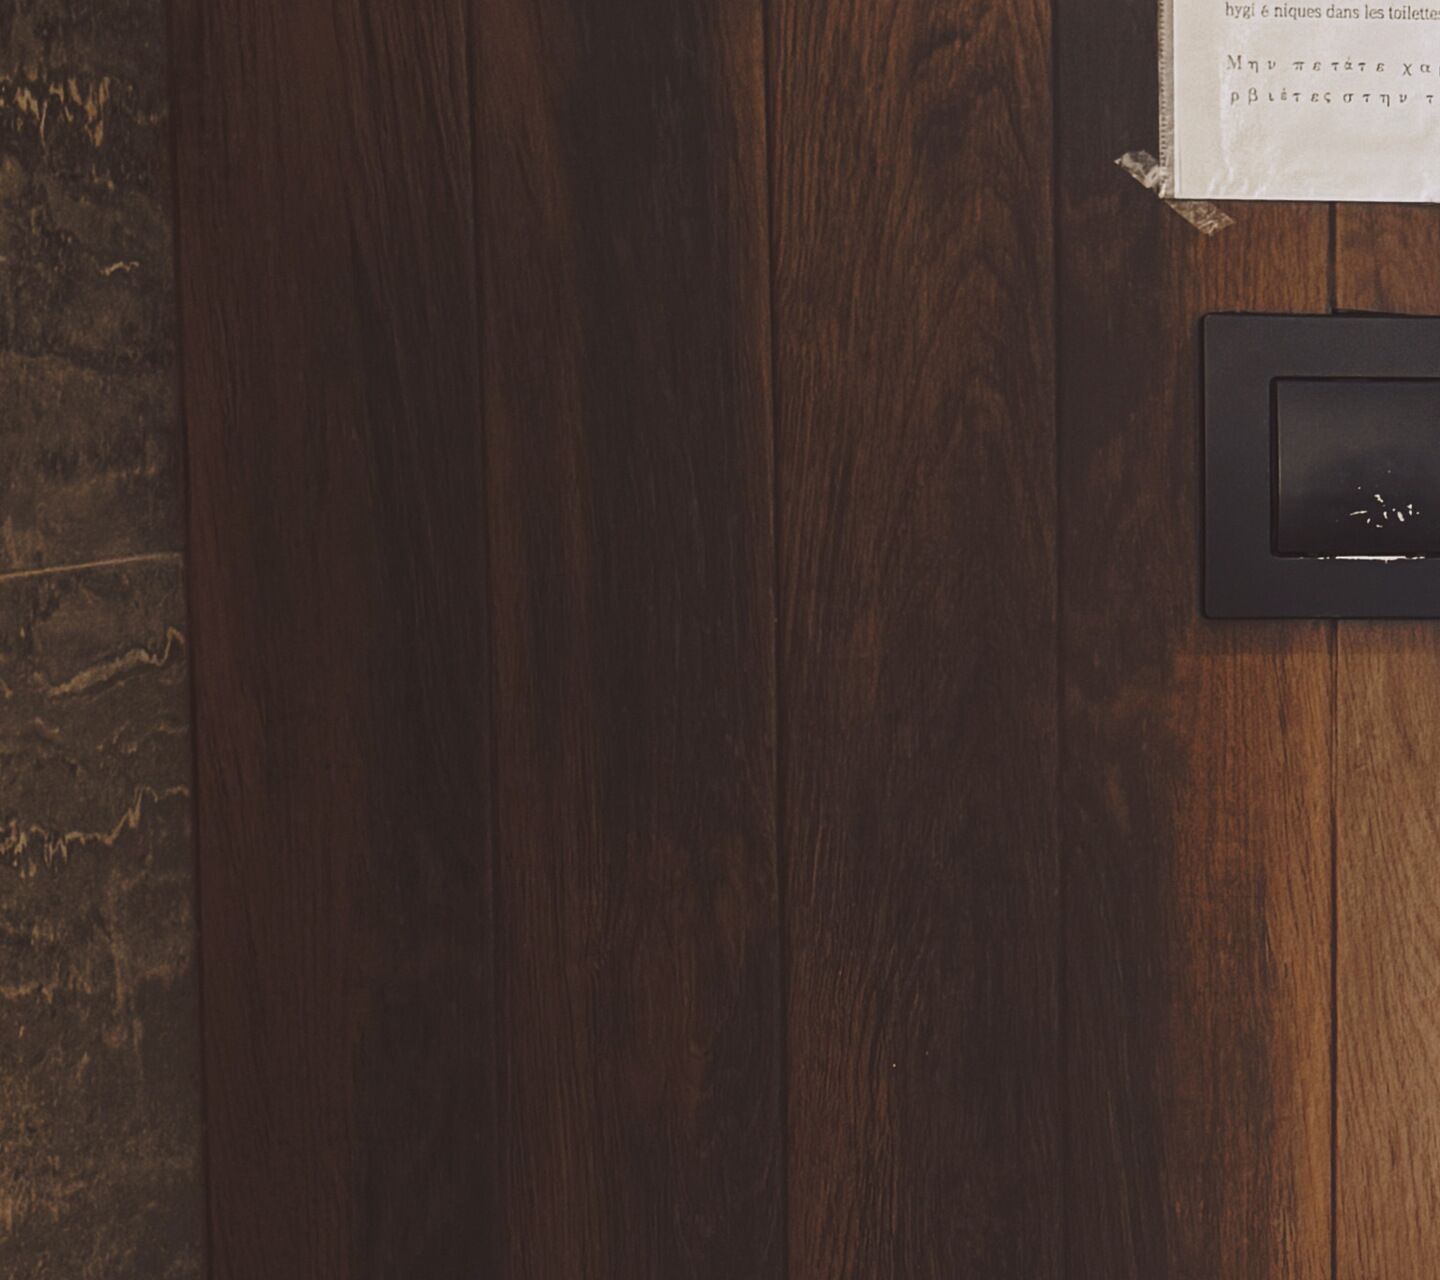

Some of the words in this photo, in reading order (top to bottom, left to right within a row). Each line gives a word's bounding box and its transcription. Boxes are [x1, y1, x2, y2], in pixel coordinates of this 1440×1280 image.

[1225, 1, 1255, 20] hygi
[1274, 3, 1322, 21] niques
[1326, 4, 1360, 20] dans
[1364, 4, 1385, 21] les
